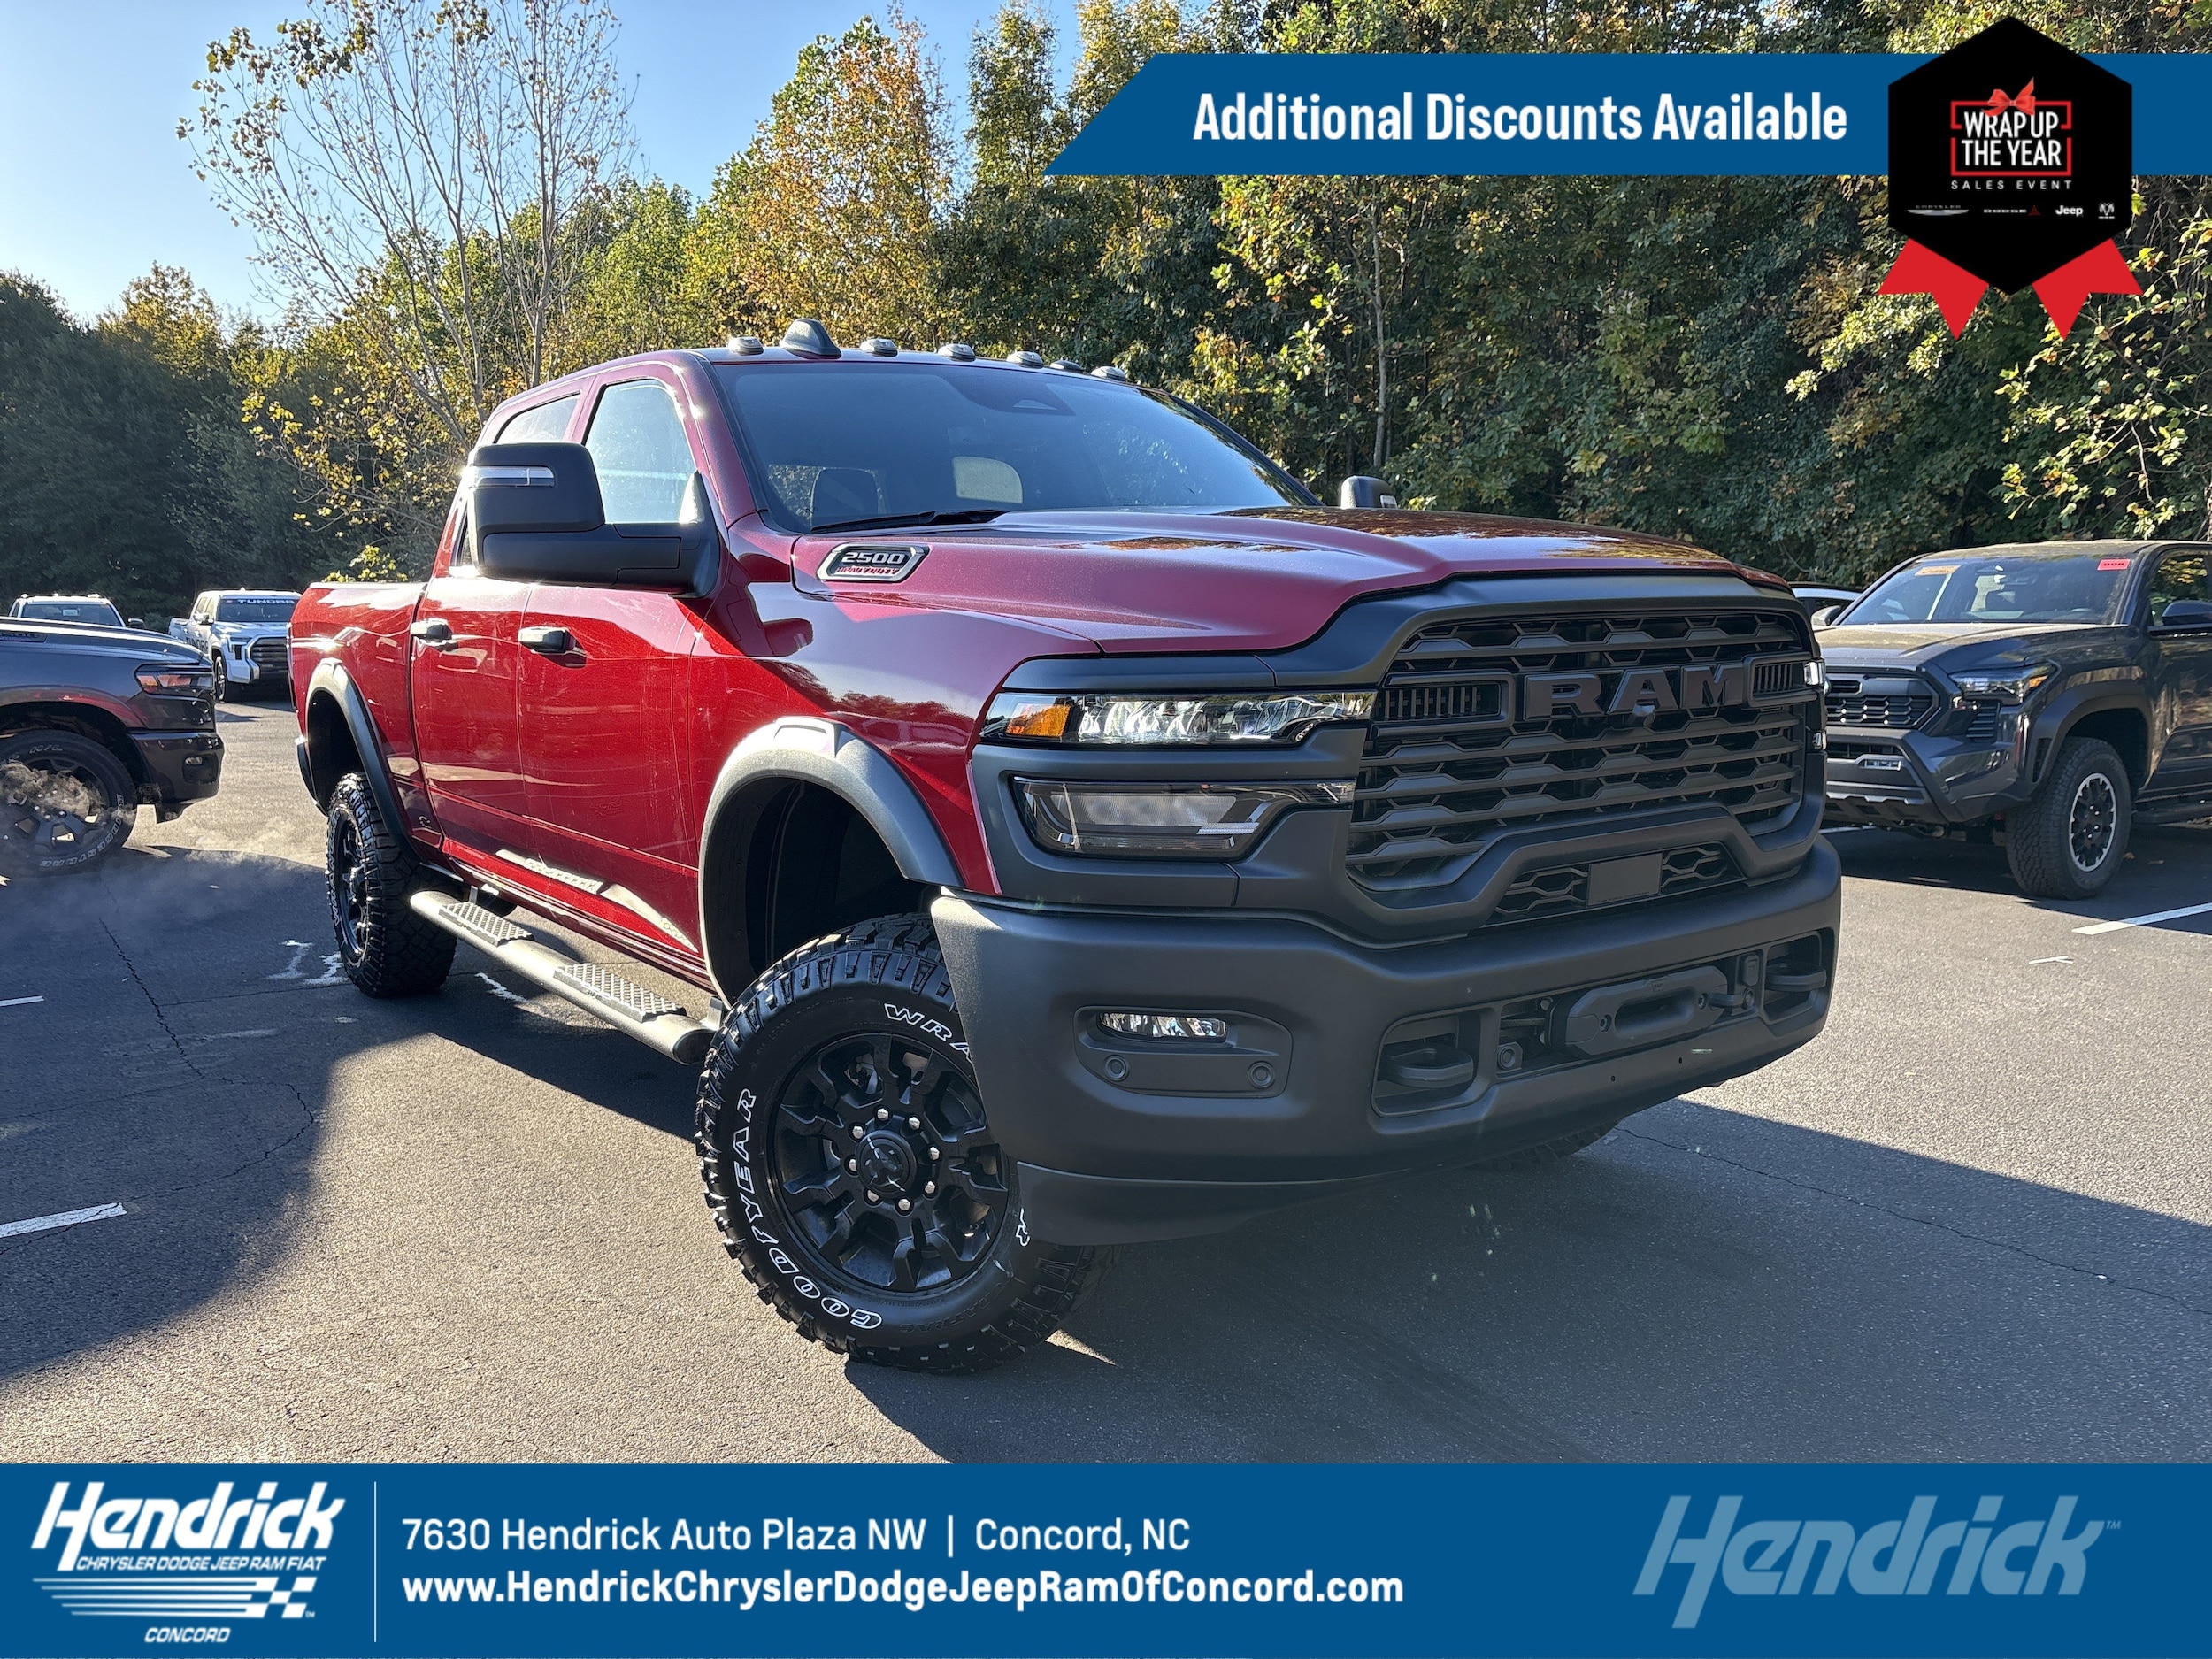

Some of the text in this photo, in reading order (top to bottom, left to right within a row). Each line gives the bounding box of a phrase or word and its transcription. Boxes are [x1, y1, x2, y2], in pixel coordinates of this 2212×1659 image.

[841, 551, 907, 565] 2500
[1523, 662, 1744, 722] RAM
[733, 1088, 883, 1329] GOODYEAR
